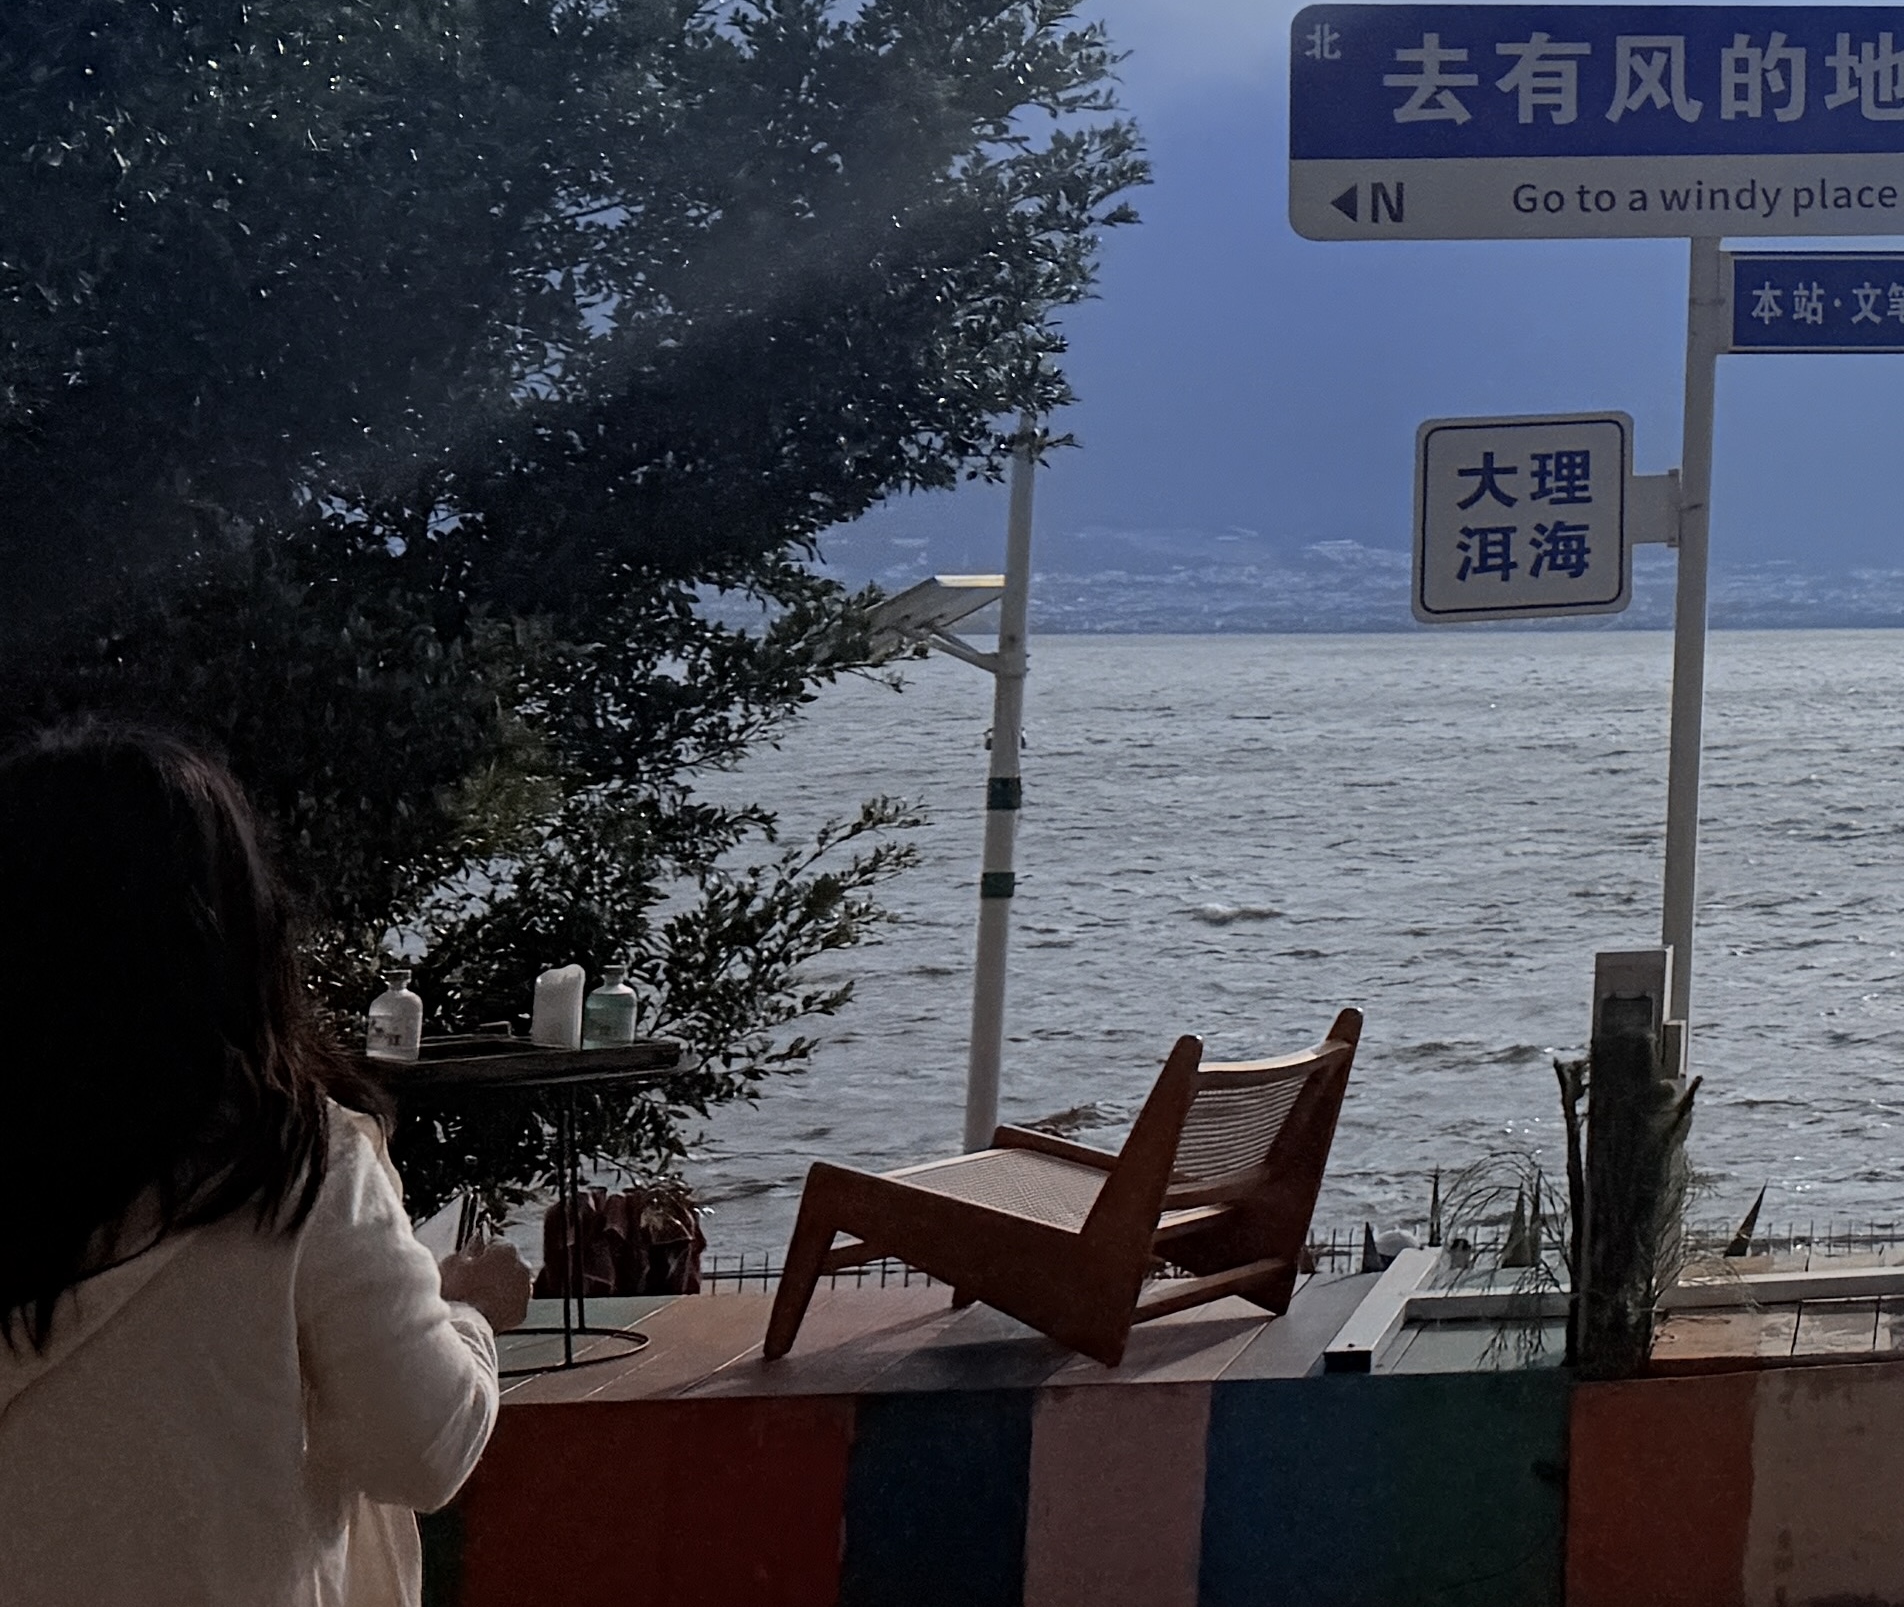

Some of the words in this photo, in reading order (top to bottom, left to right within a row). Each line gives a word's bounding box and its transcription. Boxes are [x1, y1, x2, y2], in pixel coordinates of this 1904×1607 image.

[1304, 22, 1343, 61] 北
[1370, 181, 1405, 223] N
[1511, 183, 1565, 215] Go
[1576, 179, 1617, 212] to
[1628, 187, 1648, 212] a
[1659, 177, 1782, 218] windy
[1792, 176, 1899, 216] place
[1456, 449, 1593, 511] 大理
[1455, 519, 1592, 583] 洱海
